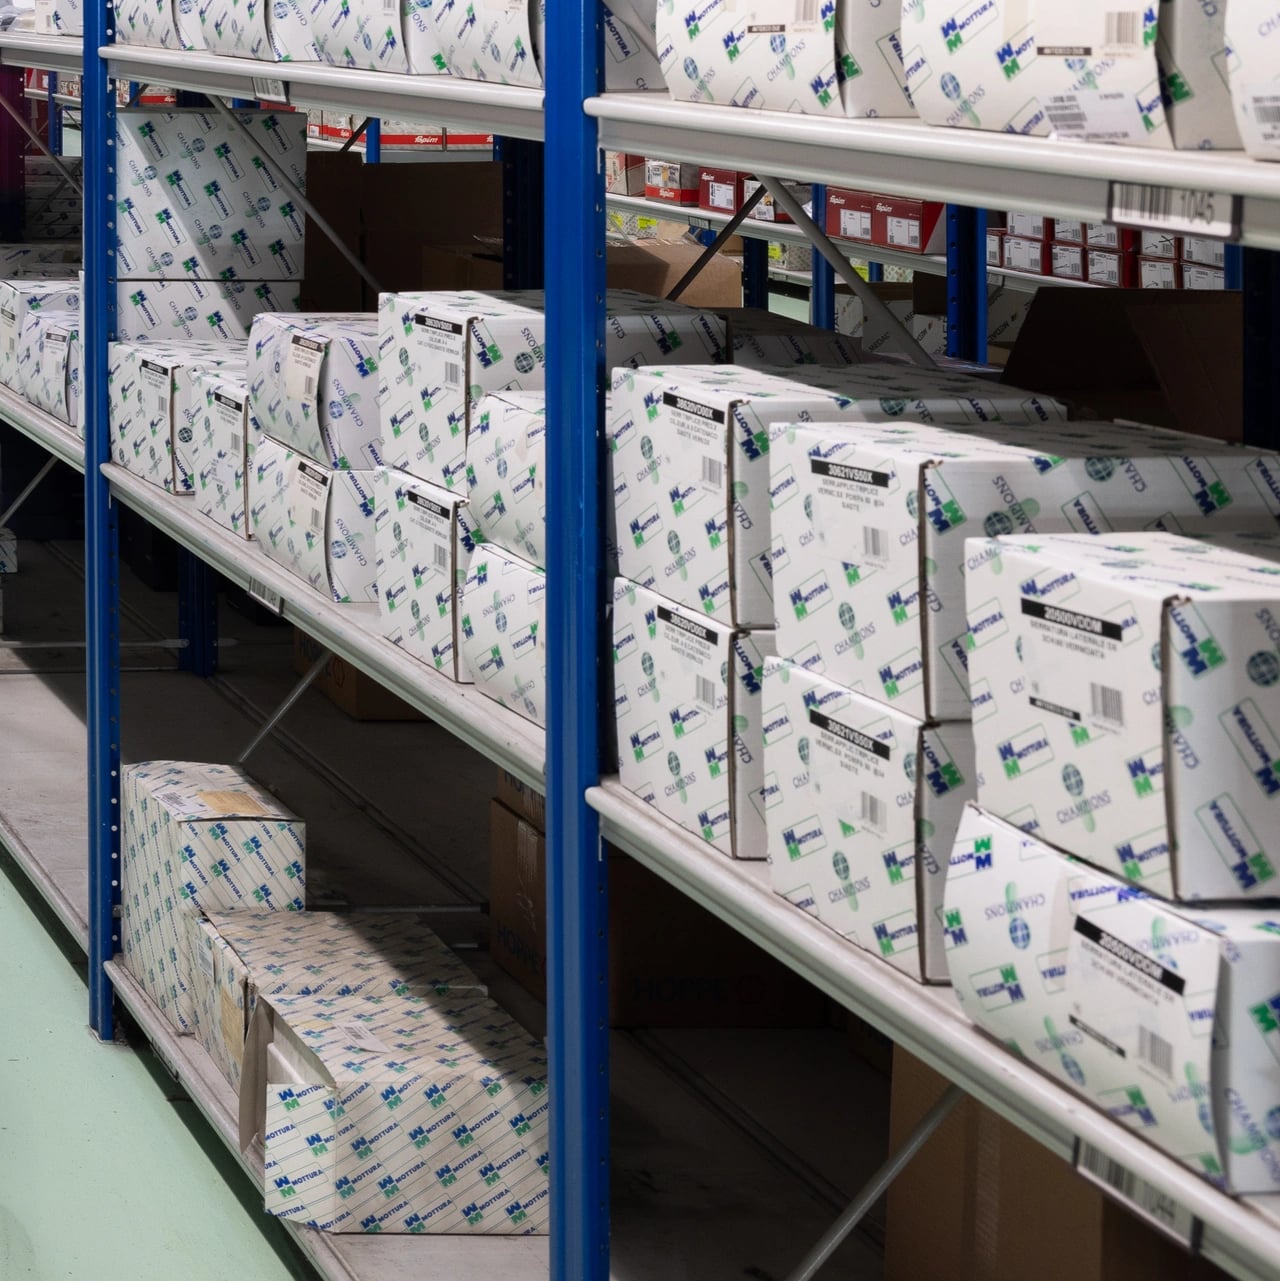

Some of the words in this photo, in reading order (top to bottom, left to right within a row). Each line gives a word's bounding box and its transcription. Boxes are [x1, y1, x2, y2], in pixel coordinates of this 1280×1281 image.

[128, 160, 152, 197] CHAMPIONS
[165, 220, 180, 244] MOTTURA
[804, 582, 829, 604] MOTTURA
[1232, 704, 1272, 762] MOTTURA
[189, 859, 209, 885] MOTTURA
[255, 850, 274, 877] MOTTURA
[264, 1124, 296, 1141] MOTTURA
[469, 1109, 500, 1133] MOTTURA
[368, 1122, 400, 1146] MOTTURA
[291, 1169, 324, 1186] MOTTURA
[378, 1199, 409, 1222] MOTTURA
